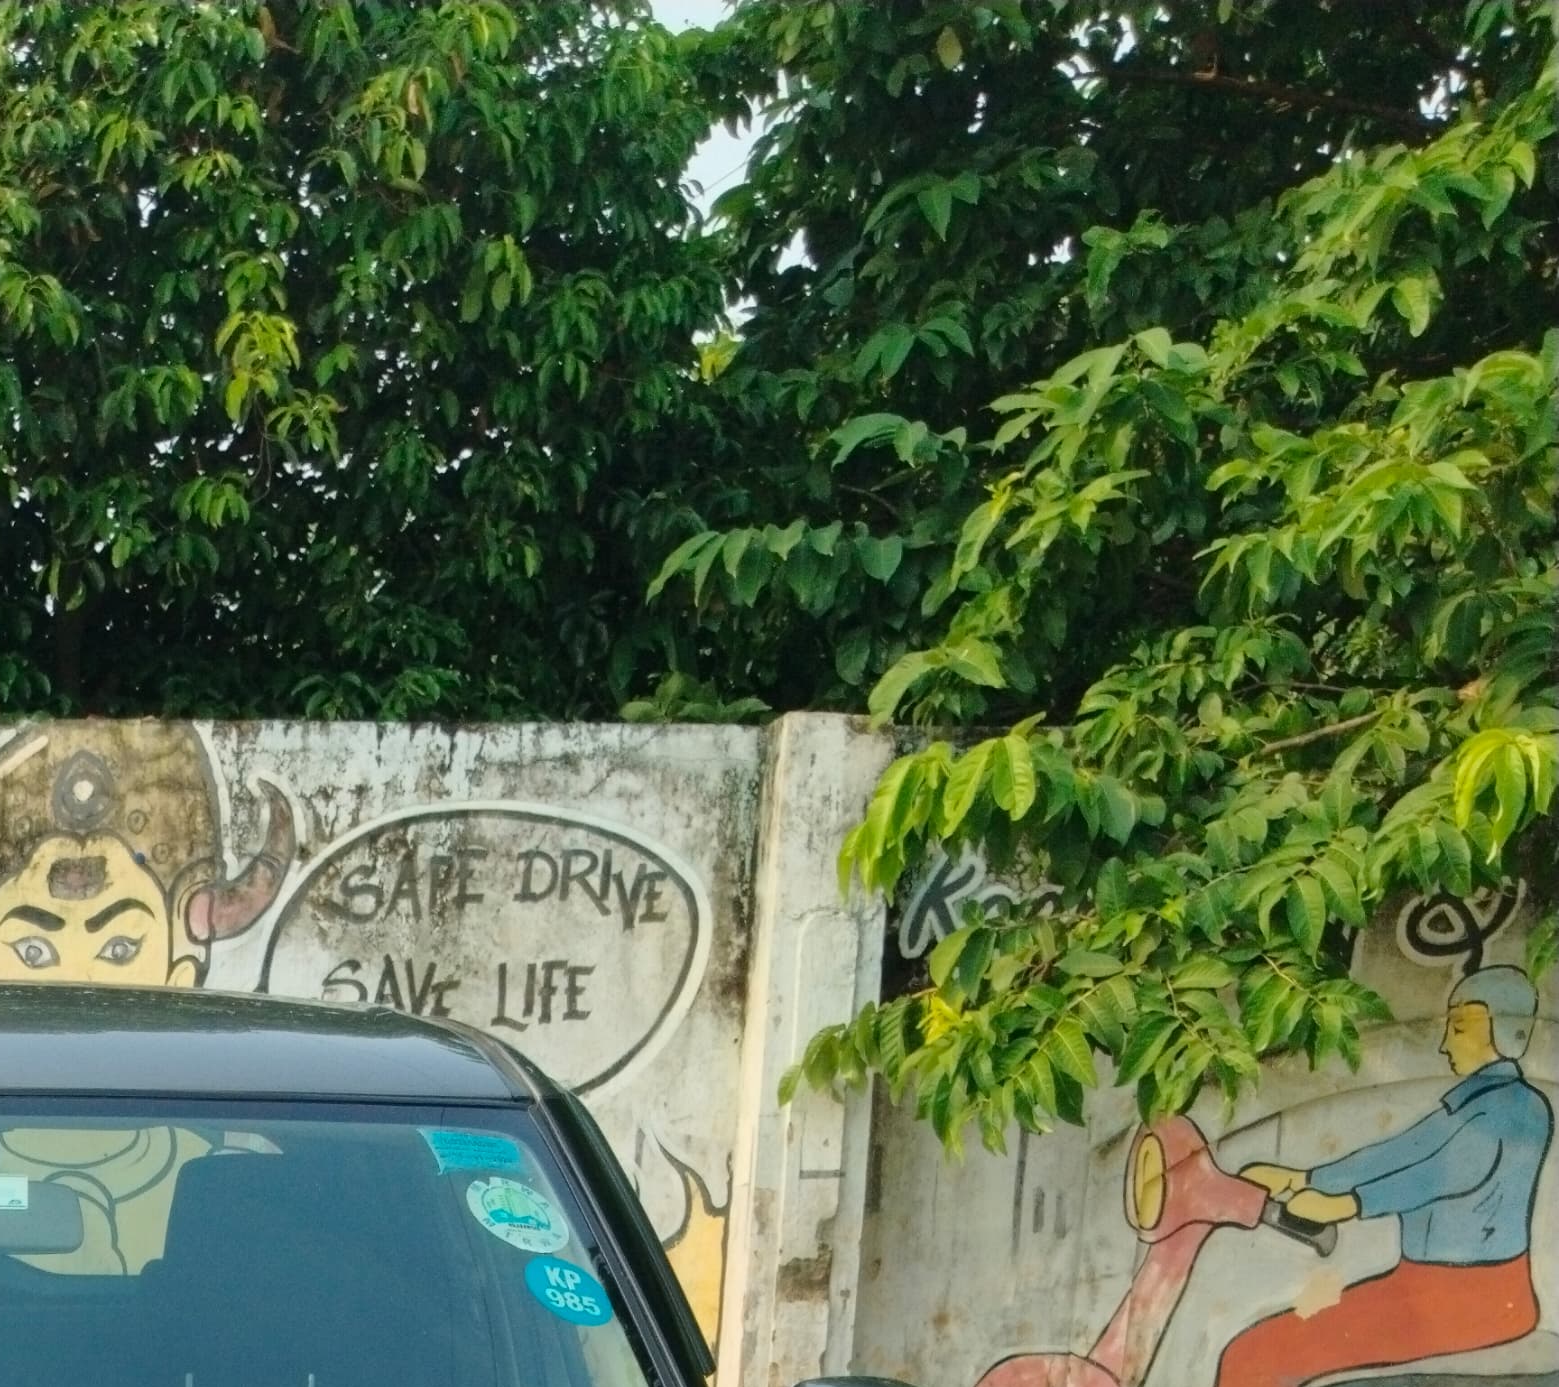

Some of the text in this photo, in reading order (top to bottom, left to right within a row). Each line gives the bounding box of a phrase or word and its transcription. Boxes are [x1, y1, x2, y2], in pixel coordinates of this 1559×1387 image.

[513, 849, 669, 930] DRIVE
[322, 953, 597, 1032] SAVE LIFE
[544, 1264, 582, 1291] KP
[545, 1288, 601, 1317] 985
